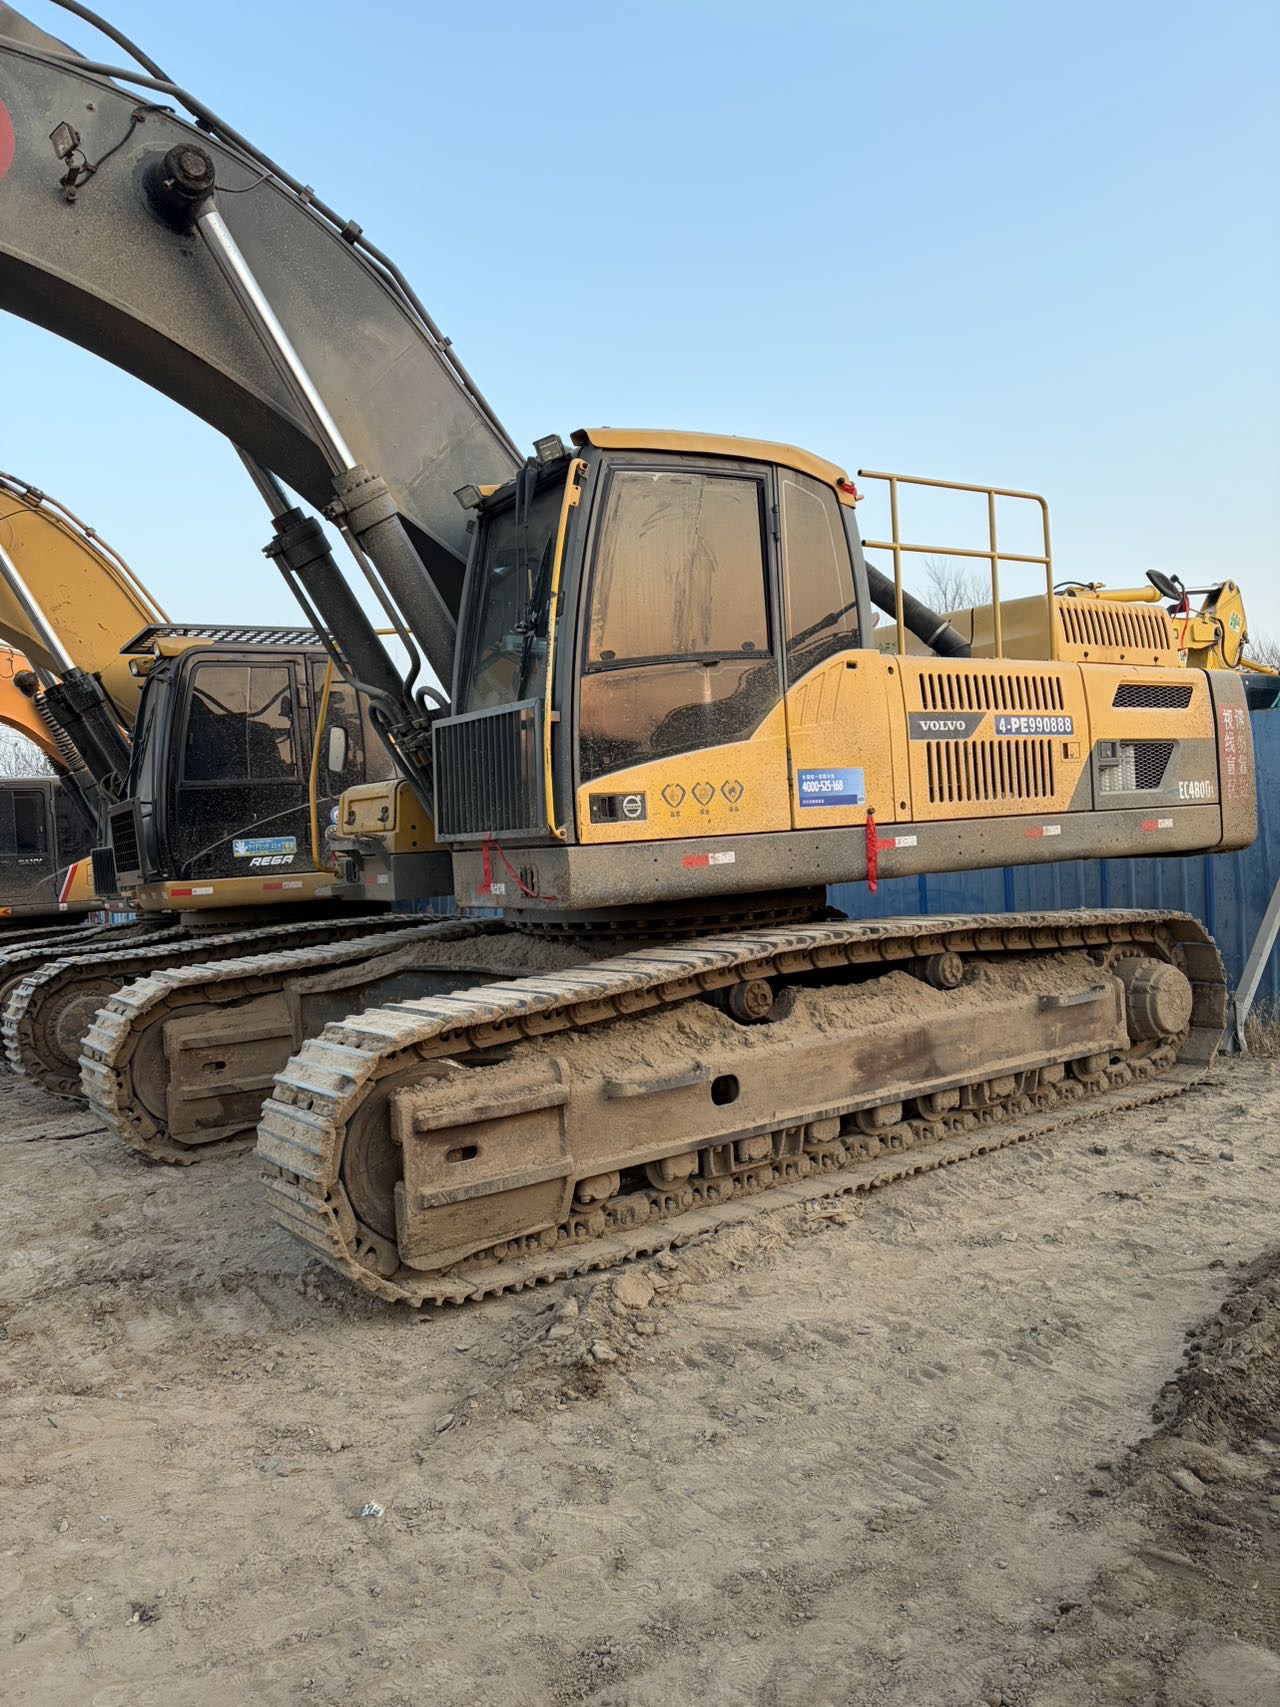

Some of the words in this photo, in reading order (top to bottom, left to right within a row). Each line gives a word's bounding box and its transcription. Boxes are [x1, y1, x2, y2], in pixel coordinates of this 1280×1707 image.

[919, 720, 966, 731] VOLVO
[999, 717, 1072, 733] 4-PE990888
[802, 780, 844, 792] 4000-525-168
[249, 855, 294, 867] REGA
